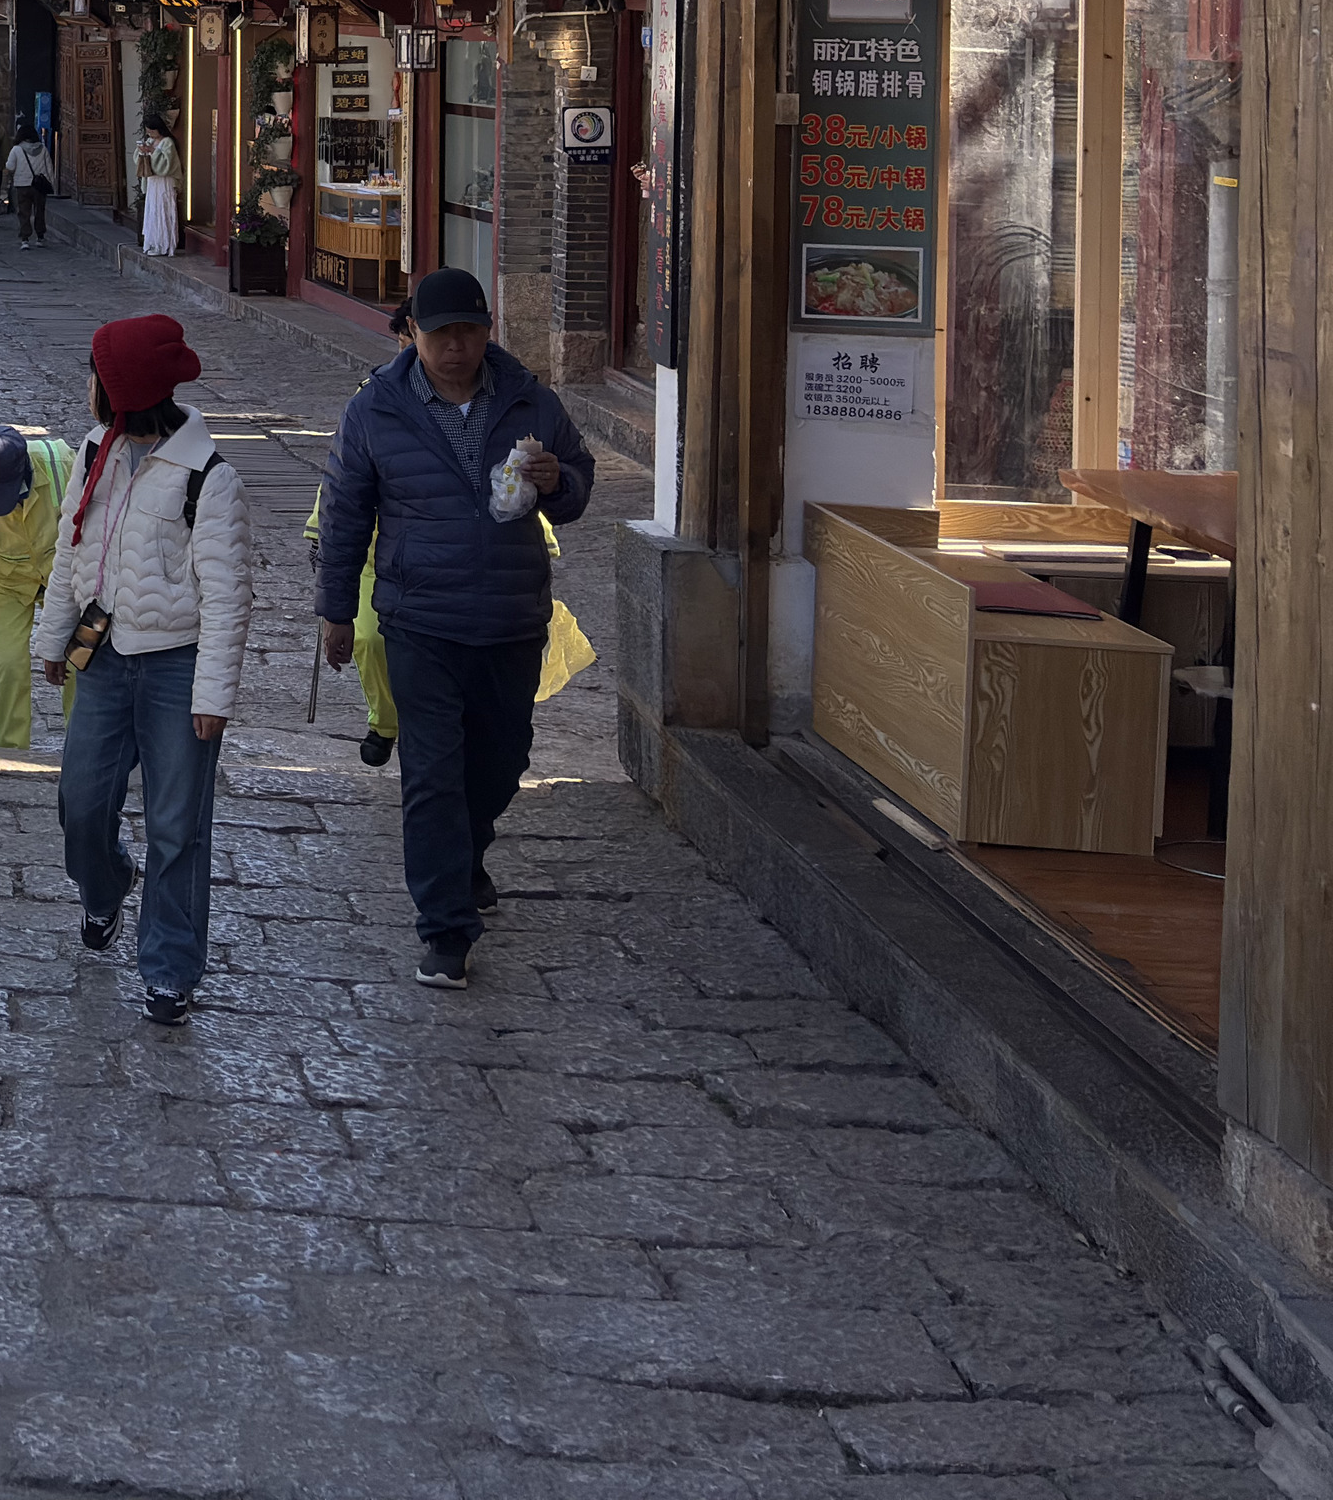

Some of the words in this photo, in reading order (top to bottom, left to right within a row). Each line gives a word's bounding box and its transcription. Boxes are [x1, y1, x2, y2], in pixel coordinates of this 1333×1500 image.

[812, 38, 922, 63] 丽江特色
[335, 73, 368, 86] 琥珀
[812, 68, 926, 99] 铜锅腊排骨
[801, 113, 928, 150] 38元/小锅
[800, 155, 927, 190] 58元/中锅
[799, 195, 926, 231] 78元/大锅
[832, 351, 880, 373] 招聘
